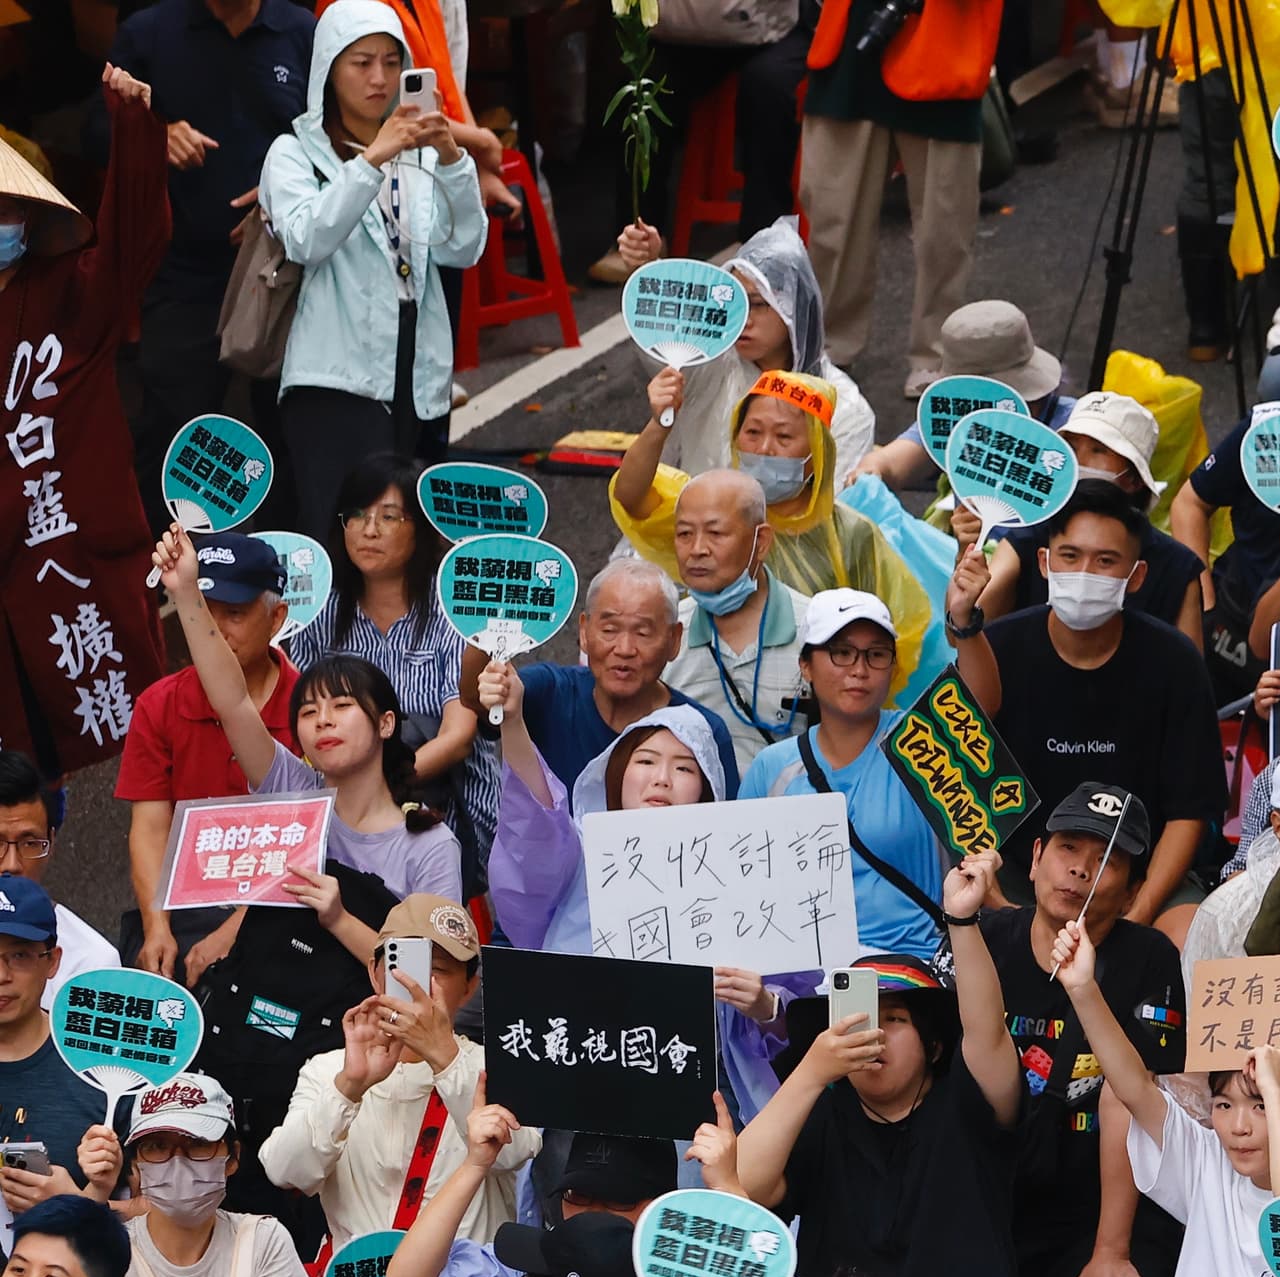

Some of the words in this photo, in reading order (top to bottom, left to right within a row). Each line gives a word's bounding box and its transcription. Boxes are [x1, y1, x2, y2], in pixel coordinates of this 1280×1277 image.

[190, 425, 247, 473] 我藐視
[968, 422, 1039, 462] 我藐視
[175, 444, 249, 503] 藍白黑箱
[958, 444, 1053, 496] 藍白黑箱
[454, 557, 532, 581] 我藐視
[451, 583, 555, 607] 藍白黑箱
[937, 689, 987, 766] LIKE
[1047, 738, 1086, 754] Calvin
[1088, 740, 1116, 753] Klein
[898, 717, 996, 854] TAIWANESE
[195, 823, 306, 853] 我的本命
[202, 851, 288, 881] 是台灣
[600, 824, 850, 895] 沒收討論
[69, 985, 153, 1022] 我藐視
[65, 1013, 177, 1051] 藍白黑箱
[501, 1017, 699, 1076] 我藐視國會
[662, 1208, 746, 1251] 我藐視
